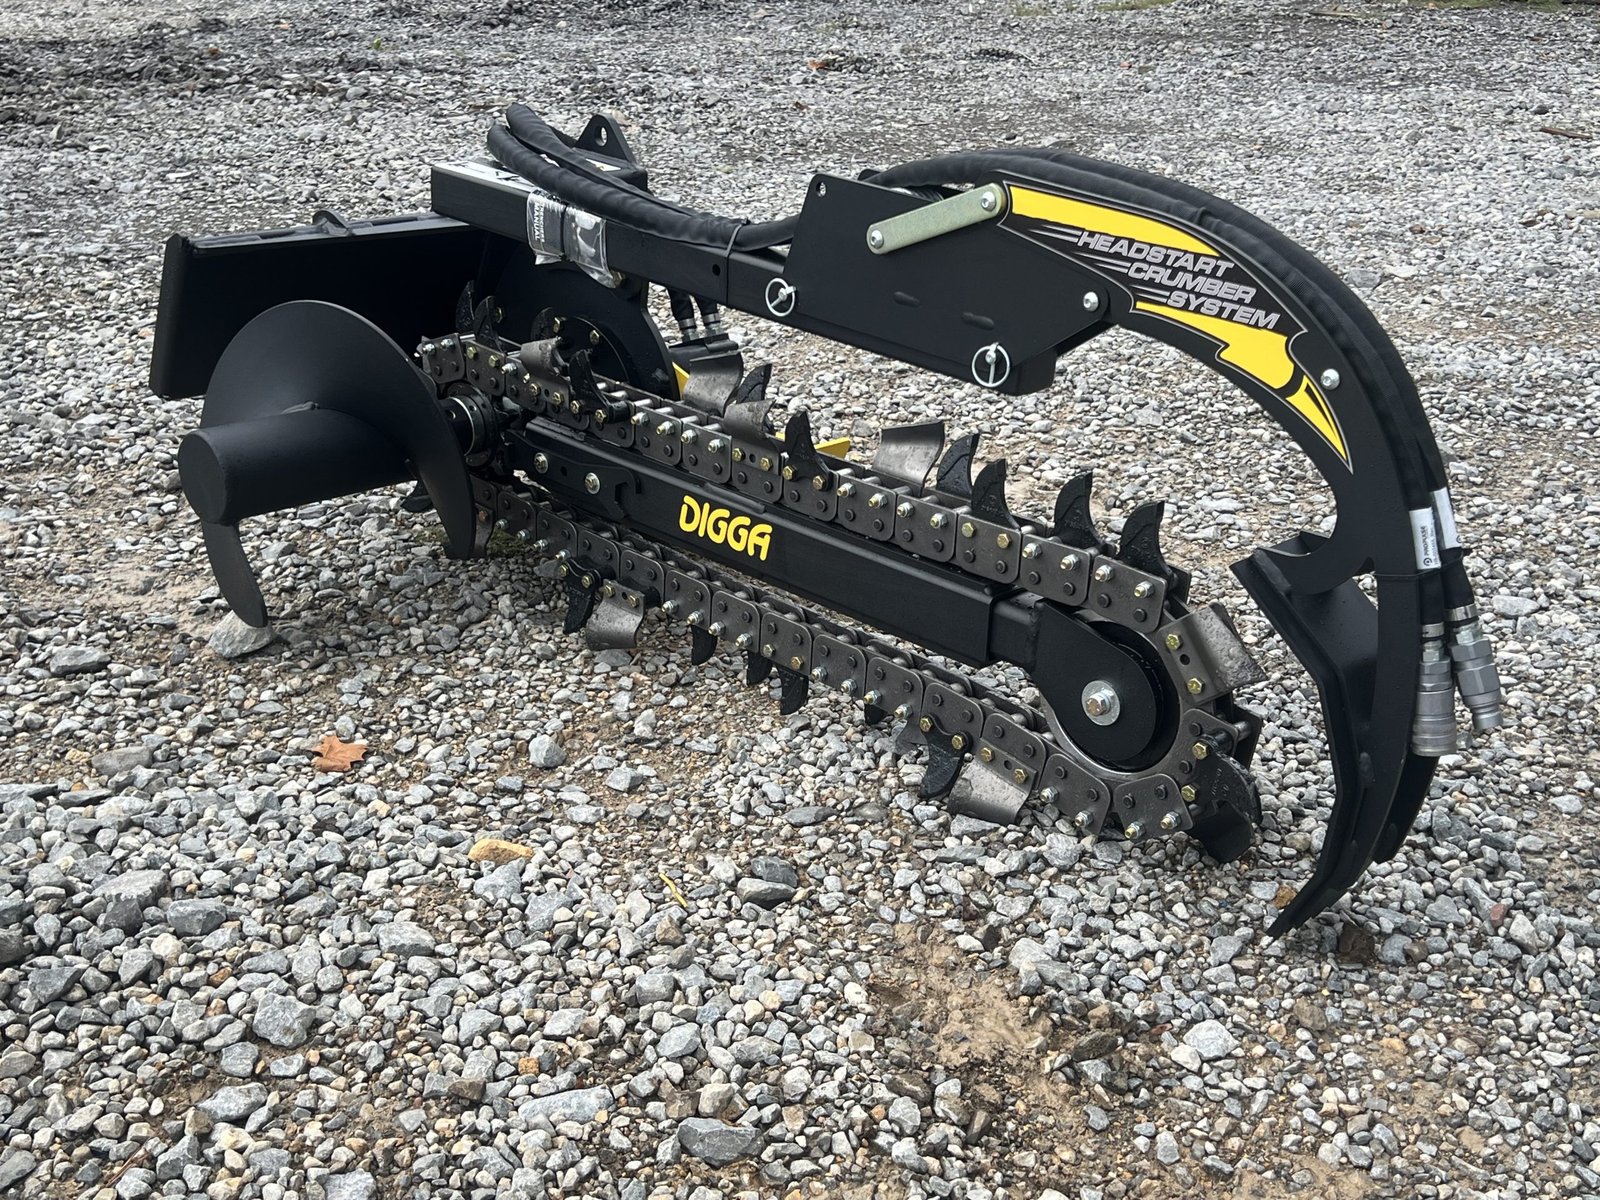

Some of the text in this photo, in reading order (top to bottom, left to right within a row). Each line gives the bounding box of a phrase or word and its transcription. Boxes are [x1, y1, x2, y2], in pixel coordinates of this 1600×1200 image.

[533, 202, 541, 241] MANUAL
[1077, 231, 1235, 277] HEADSTART
[1127, 262, 1257, 304] CRUMBER
[1167, 291, 1280, 330] SYSTEM
[679, 495, 773, 561] DIGGA
